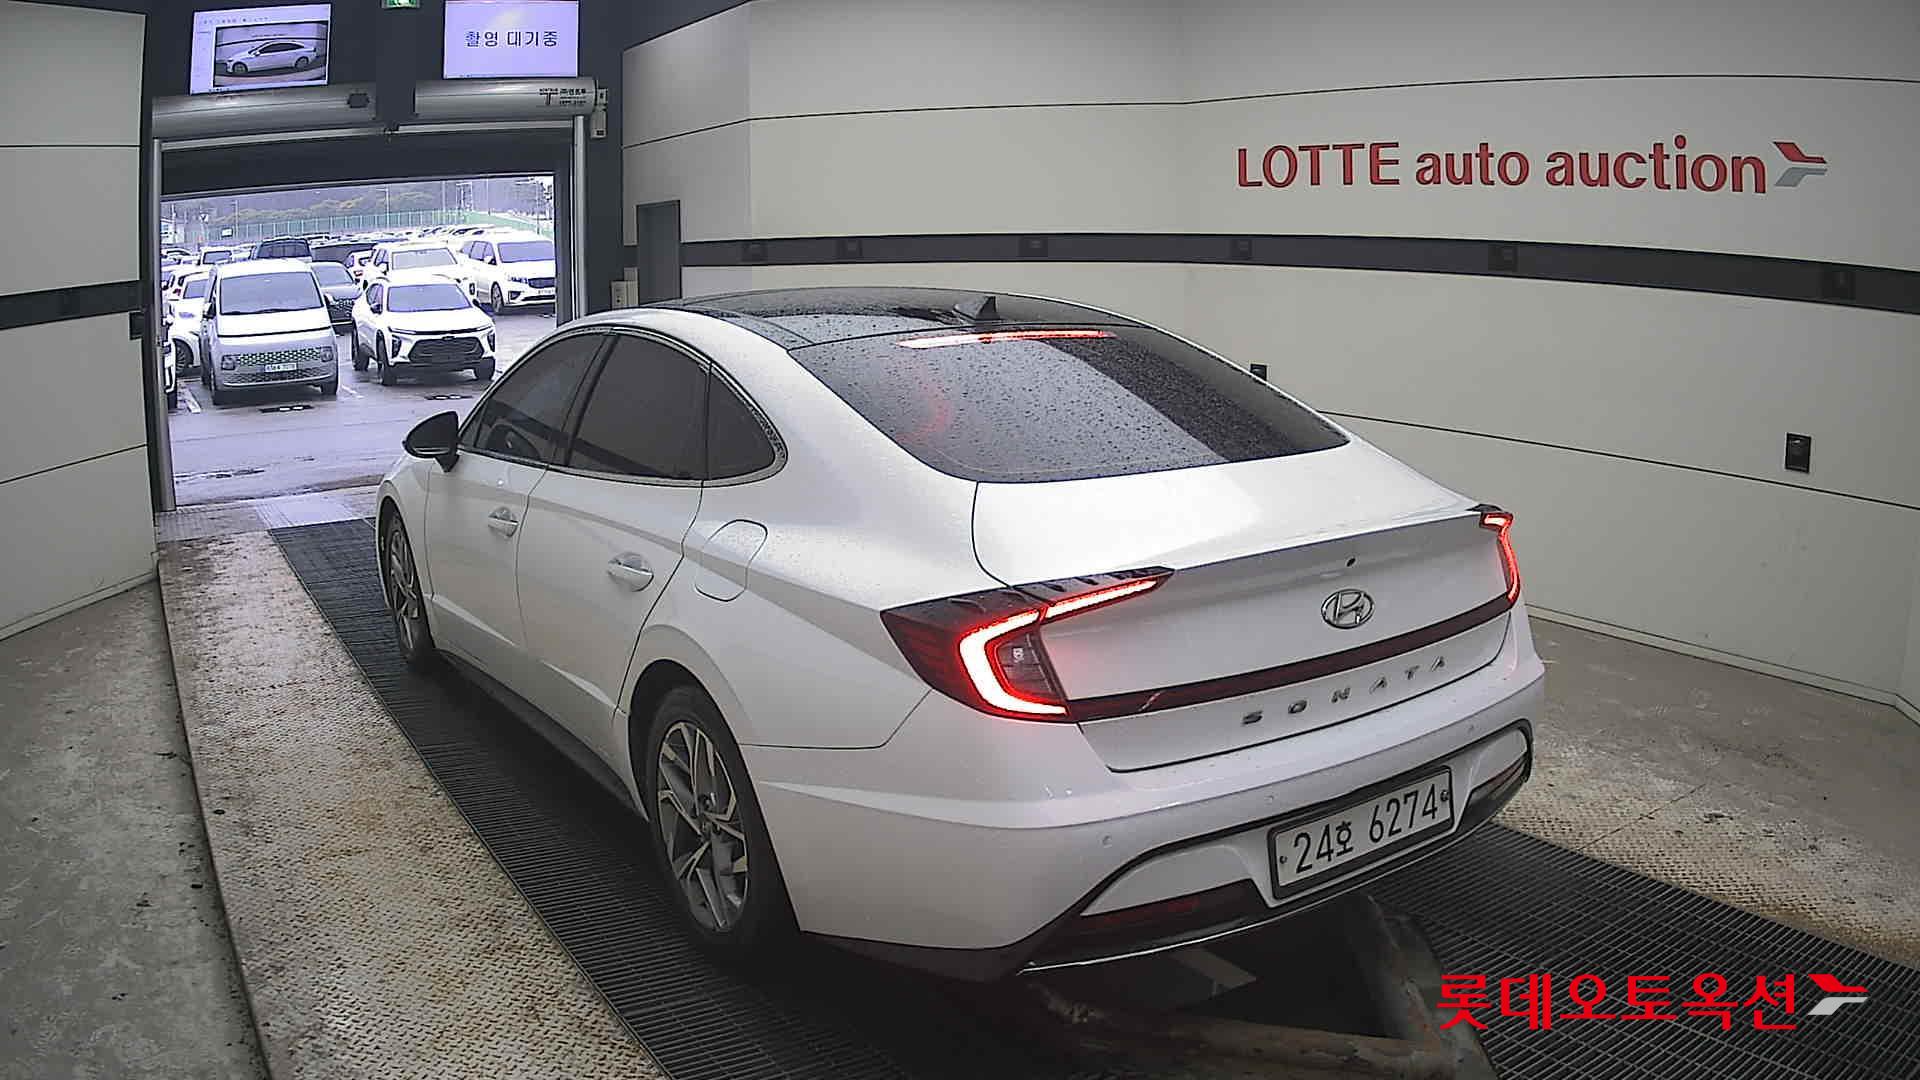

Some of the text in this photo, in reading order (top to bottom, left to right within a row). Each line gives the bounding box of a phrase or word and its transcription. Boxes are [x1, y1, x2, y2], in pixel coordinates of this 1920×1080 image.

[465, 31, 557, 47] 촬영 대기중
[1237, 135, 1767, 194] LOTTE auto auction
[1242, 656, 1445, 726] SONATA
[1294, 784, 1438, 874] 24호 6274
